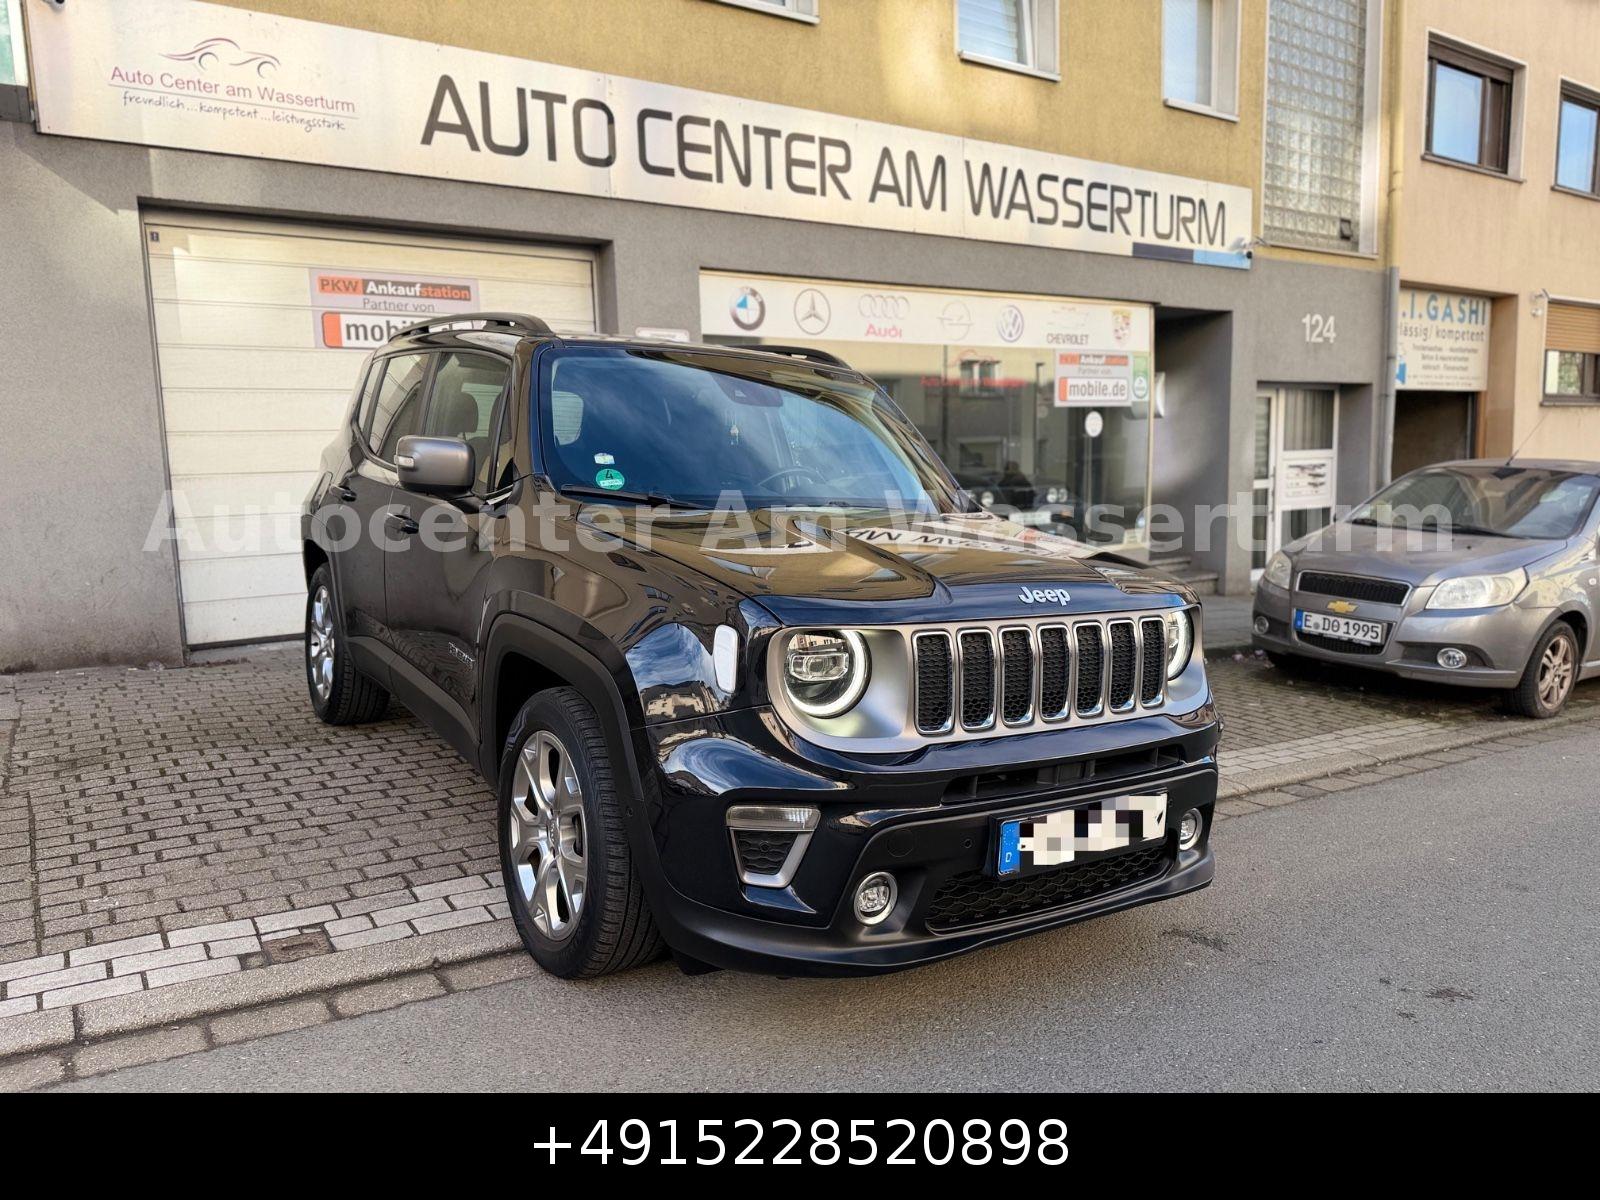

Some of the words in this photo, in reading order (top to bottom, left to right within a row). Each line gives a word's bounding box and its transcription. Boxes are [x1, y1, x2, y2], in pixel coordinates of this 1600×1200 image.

[110, 66, 154, 87] Auto
[160, 72, 220, 95] Center
[226, 84, 252, 99] am
[257, 86, 356, 113] Wasserturm
[420, 74, 617, 168] AUTO
[637, 108, 851, 200] CENTER
[869, 146, 948, 212] AM
[964, 159, 1225, 247] WASSERTURM
[319, 278, 359, 293] PKW
[366, 281, 471, 300] Ankaufstation
[363, 298, 408, 312] Partner
[409, 303, 435, 313] von
[865, 323, 903, 338] Audi
[1302, 313, 1337, 343] 124
[1047, 333, 1089, 345] CHEVROLET
[1069, 380, 1126, 397] mobile.de
[605, 469, 614, 480] 4
[1018, 586, 1071, 606] Jeep
[1304, 614, 1313, 629] E
[1322, 617, 1340, 633] DO
[1343, 621, 1380, 640] 1995
